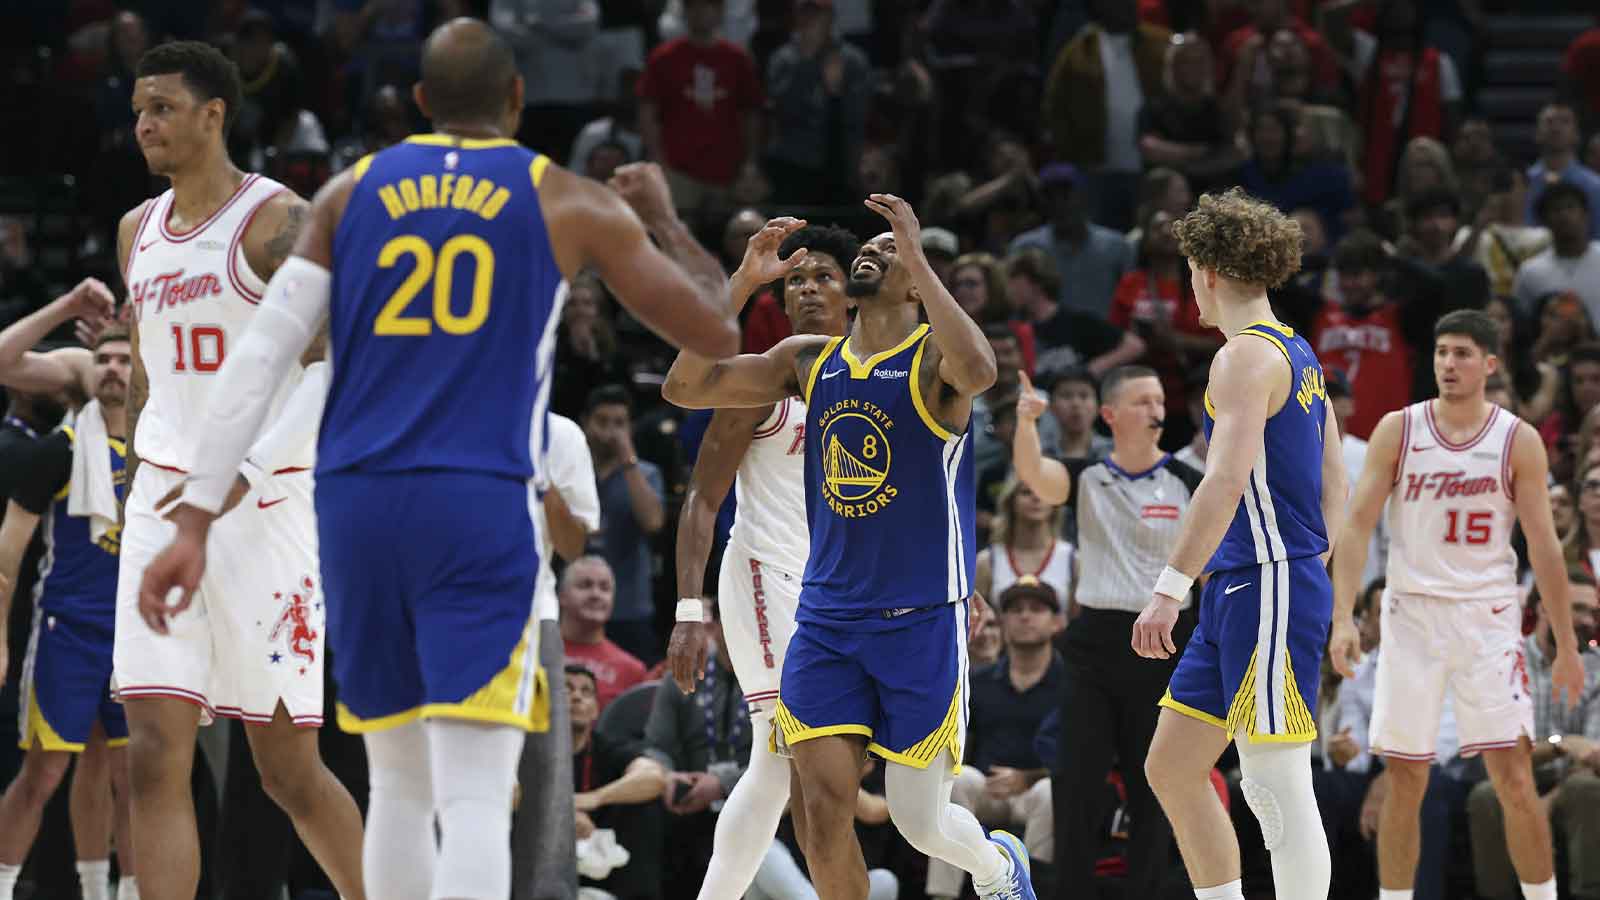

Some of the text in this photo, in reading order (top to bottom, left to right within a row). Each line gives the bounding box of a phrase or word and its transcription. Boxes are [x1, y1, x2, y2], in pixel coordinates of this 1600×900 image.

[378, 173, 512, 220] HORFORD
[374, 234, 496, 336] 20
[171, 324, 226, 373] 10
[873, 368, 908, 378] Rakuten
[818, 400, 895, 430] GOLDEN STATE
[862, 434, 878, 460] 8
[821, 481, 898, 518] WARRIORS
[1404, 470, 1498, 502] H-Town
[1444, 510, 1493, 545] 15
